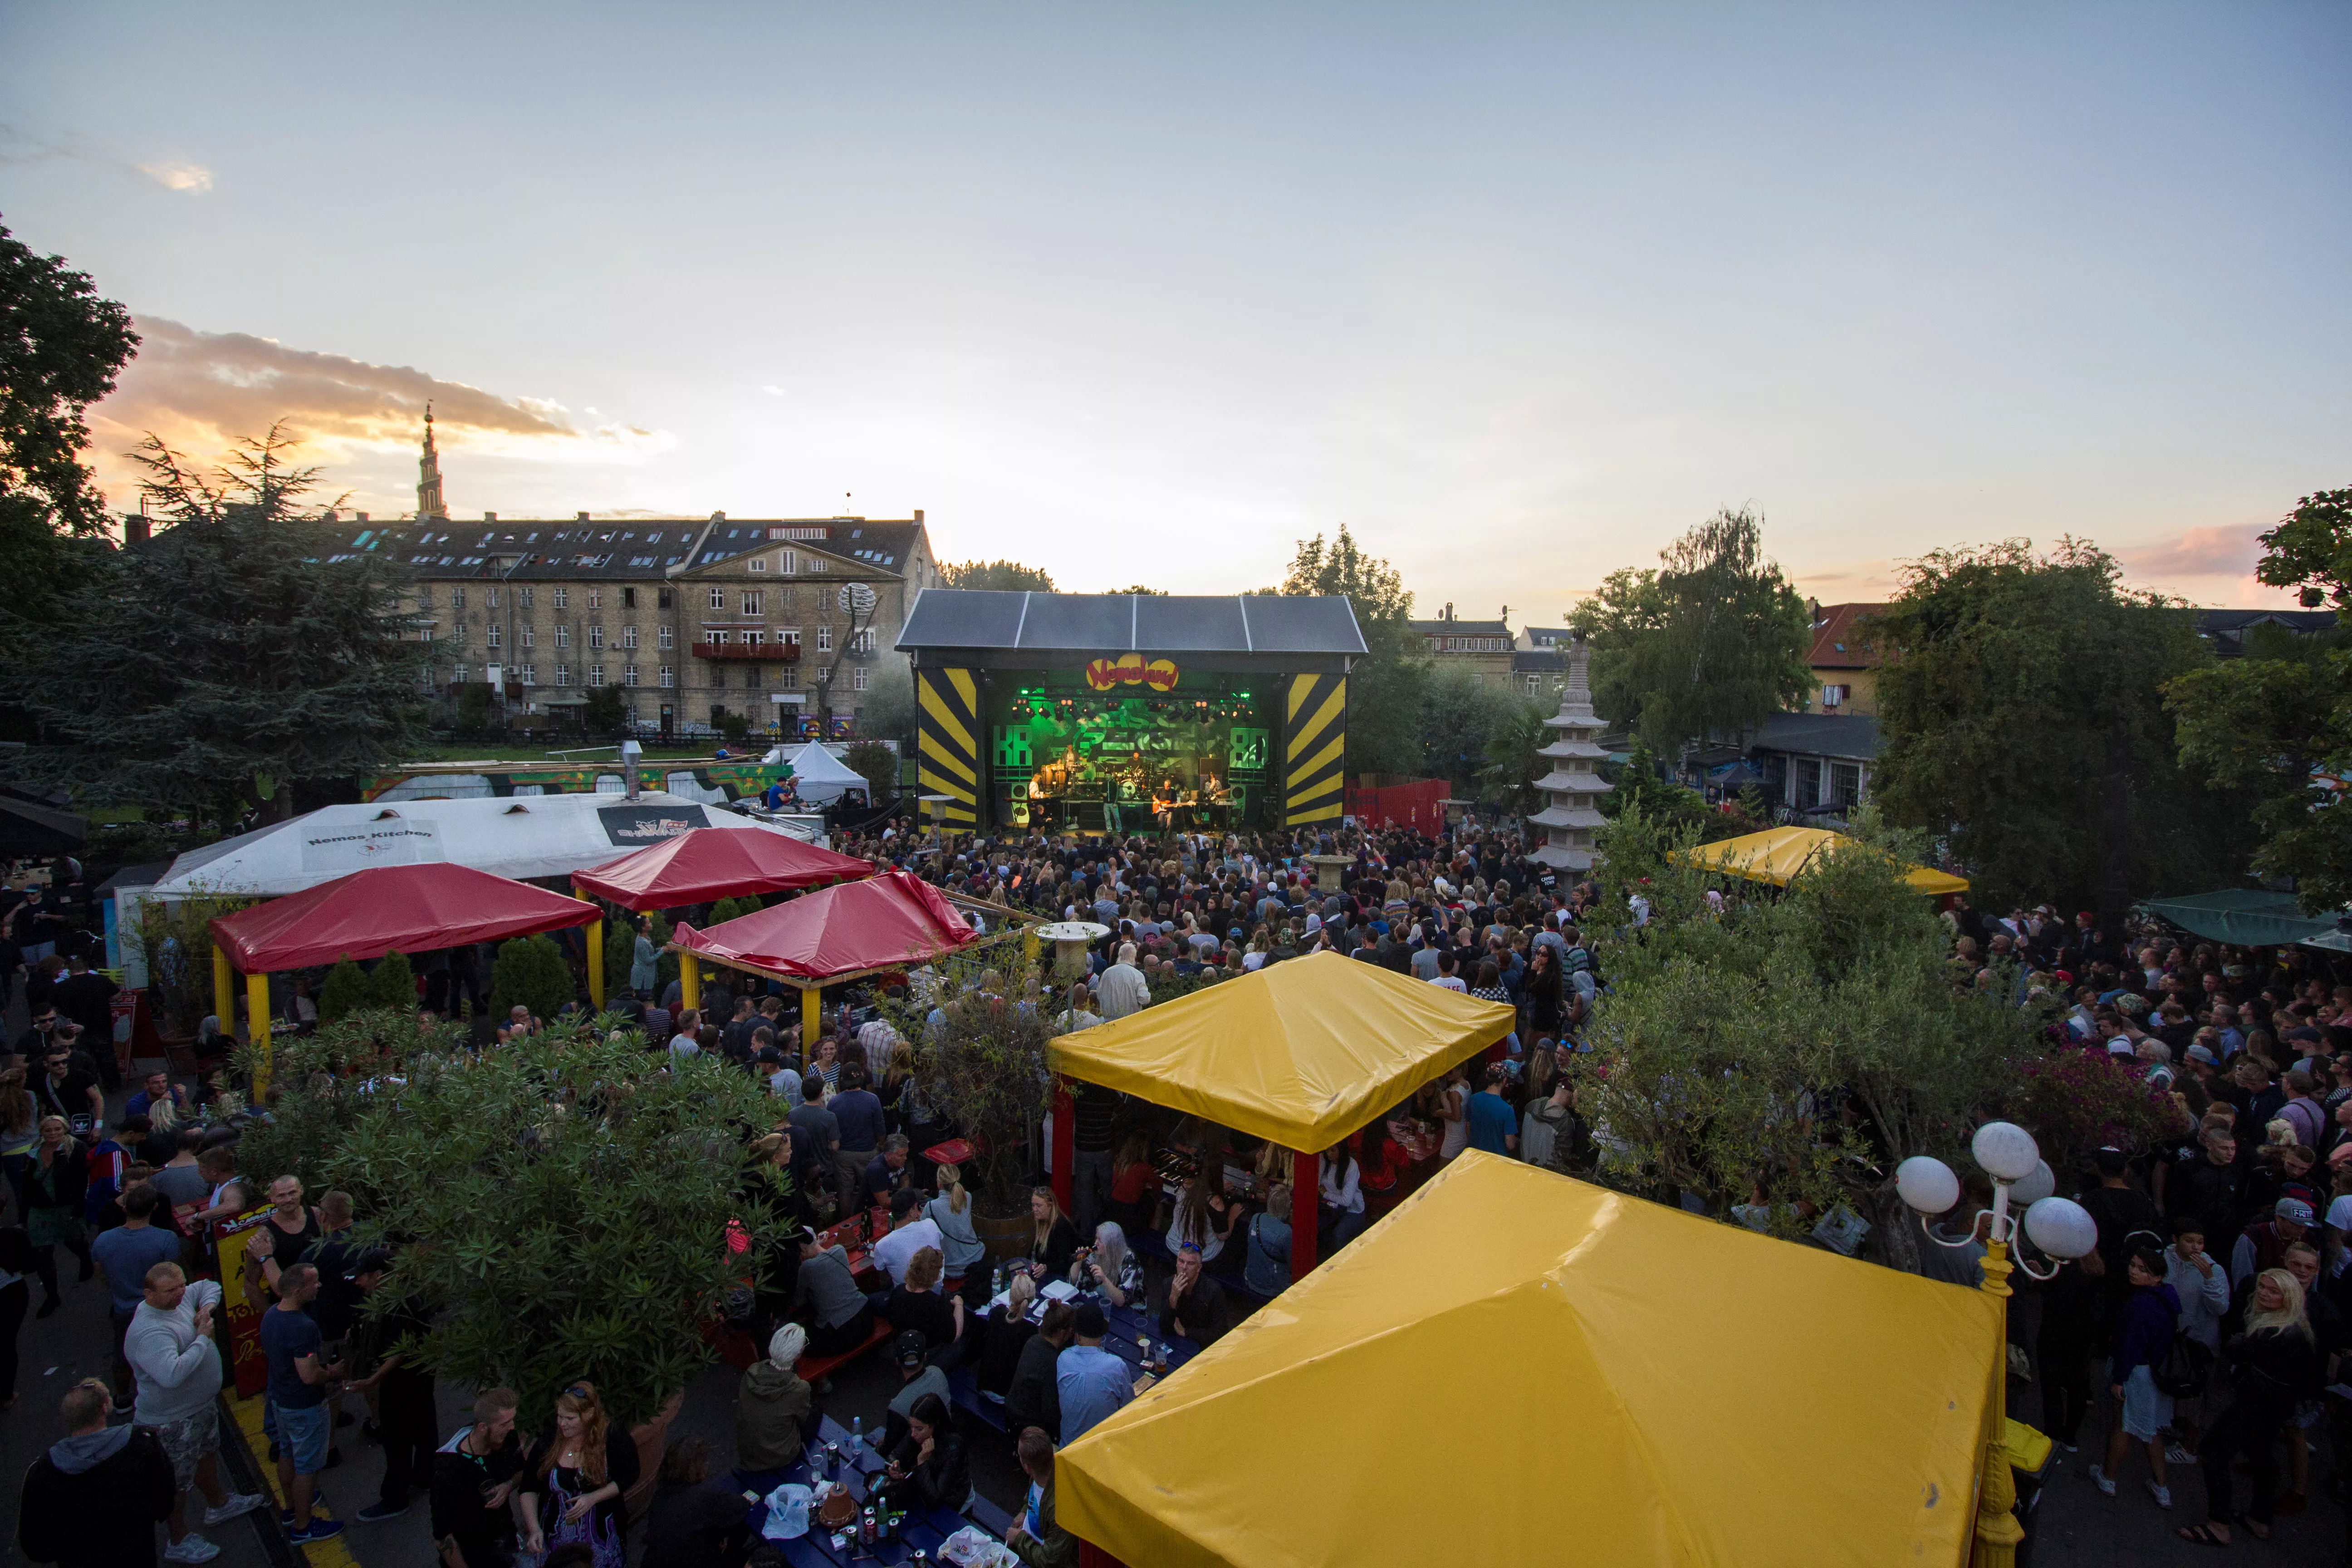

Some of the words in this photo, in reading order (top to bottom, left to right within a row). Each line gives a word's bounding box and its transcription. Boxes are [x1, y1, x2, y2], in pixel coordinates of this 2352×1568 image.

[1087, 657, 1180, 694] Nemoland
[308, 834, 366, 846] Nemos
[372, 830, 432, 839] Kitchen
